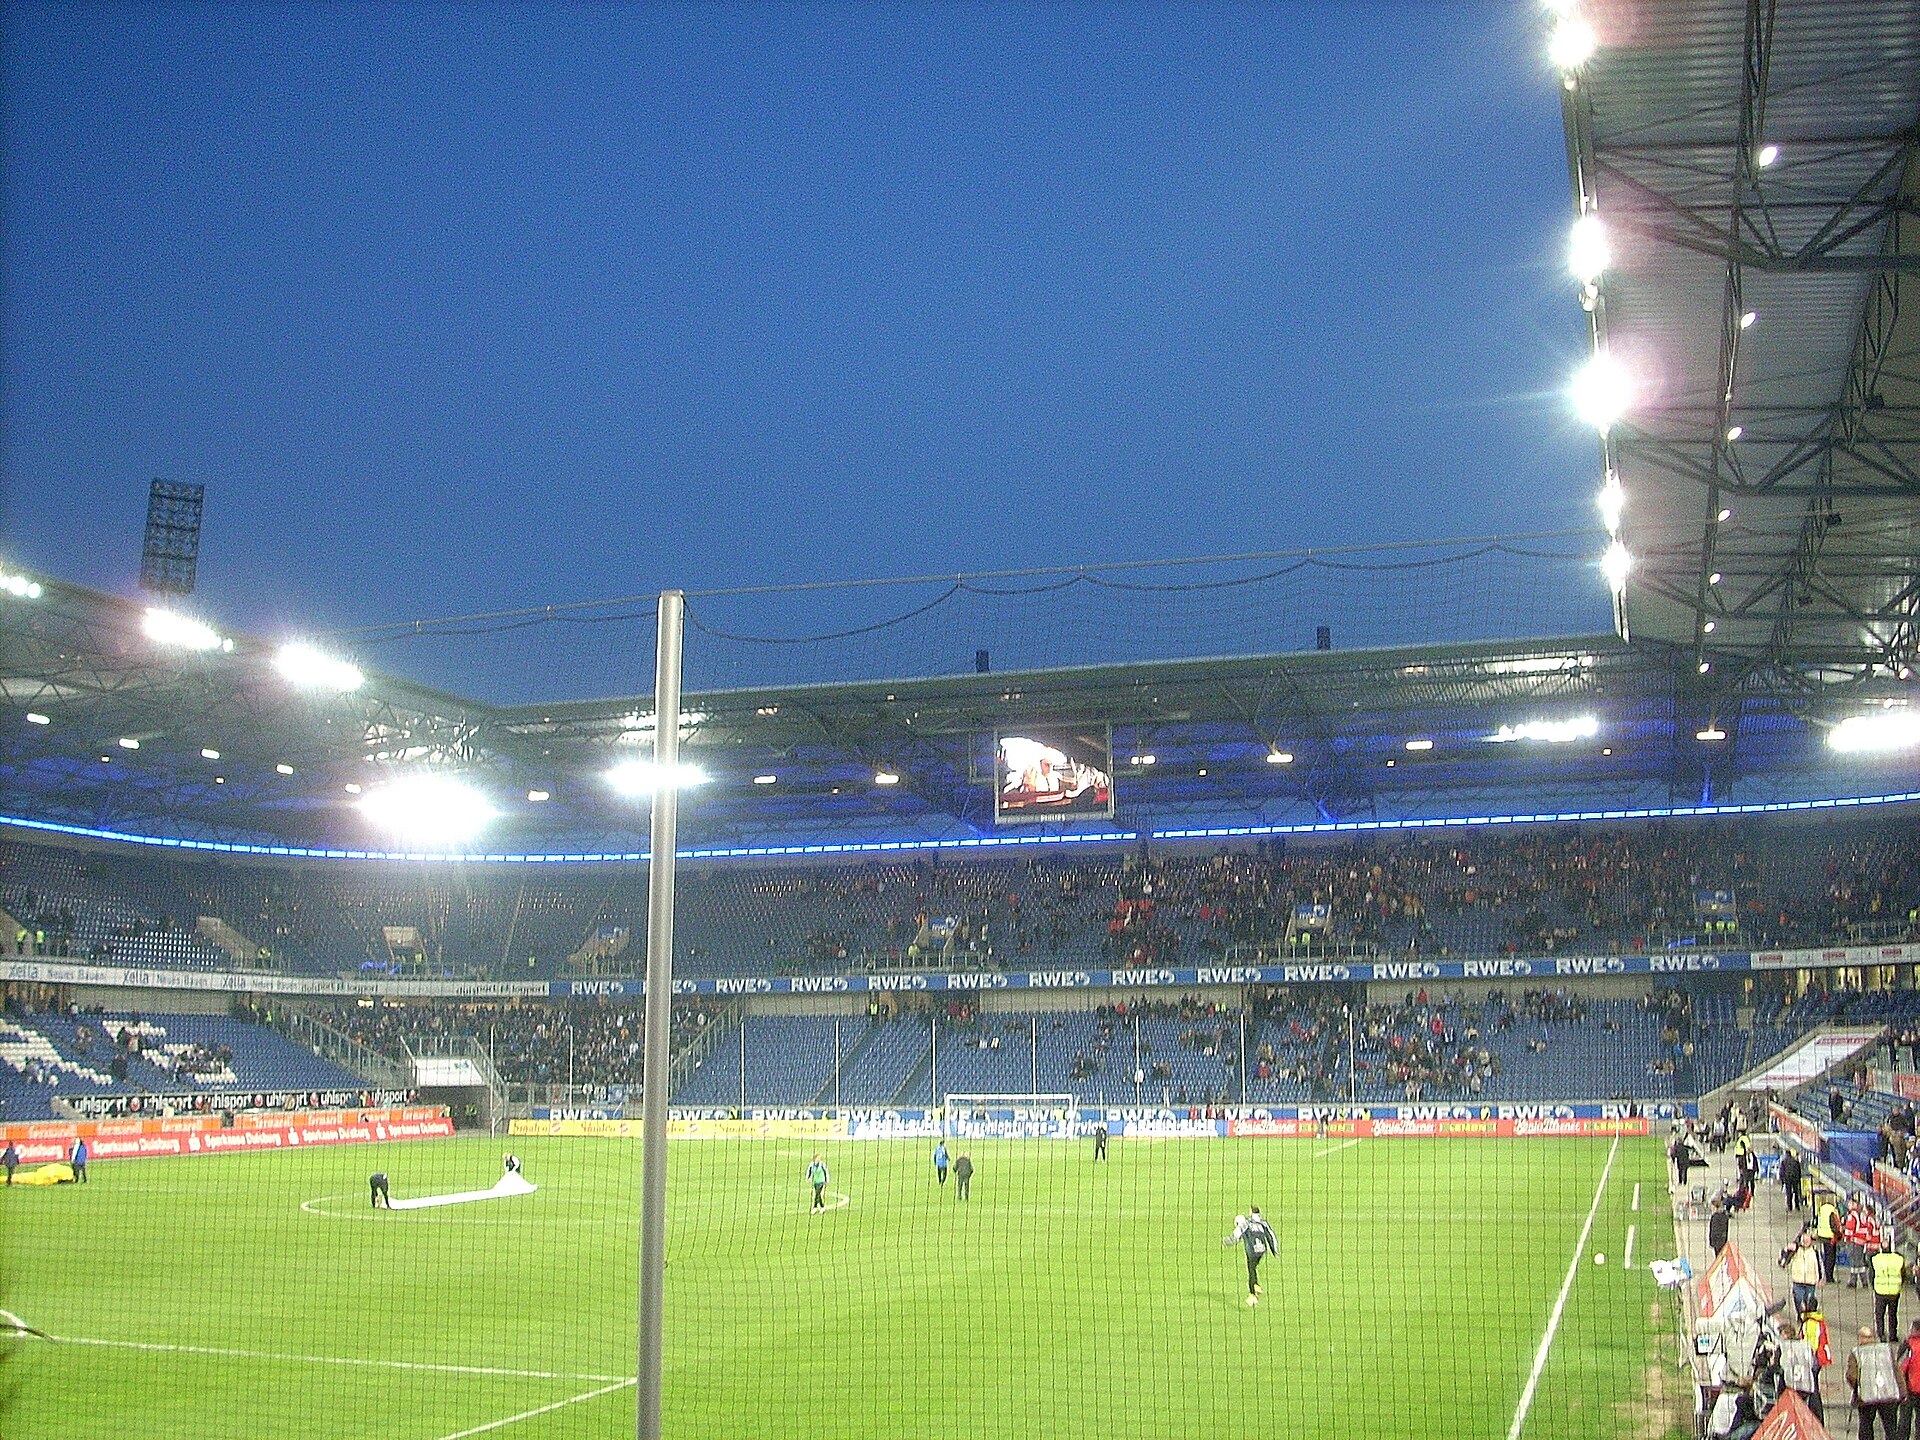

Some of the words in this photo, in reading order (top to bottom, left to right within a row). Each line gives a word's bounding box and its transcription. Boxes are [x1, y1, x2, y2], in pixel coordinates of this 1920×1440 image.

[1373, 963, 1422, 979] RWE
[1463, 960, 1513, 977] RWE
[1556, 958, 1606, 974] RWE
[1650, 955, 1700, 972] RWE
[123, 969, 149, 984] Xella
[947, 972, 992, 988] RWE
[1029, 972, 1075, 987] RWE
[1112, 970, 1158, 985] RWE
[1198, 967, 1245, 983] RWE
[1284, 966, 1332, 982] RWE
[222, 975, 247, 989] Xella
[571, 981, 610, 995] RWE
[716, 980, 757, 993] RWE
[791, 978, 833, 993] RWE
[868, 975, 911, 990] RWE
[550, 1108, 591, 1121] RWE
[1398, 1106, 1450, 1121] RWE
[1500, 1105, 1555, 1119] RWE
[302, 1129, 338, 1143] Sparkasse
[338, 1127, 371, 1141] Duisburg
[388, 1124, 420, 1138] Sparkasse
[420, 1122, 449, 1136] Duisburg
[92, 1139, 139, 1155] Sparkasse
[140, 1137, 180, 1152] Duisburg
[205, 1133, 246, 1150] Sparkasse
[246, 1132, 281, 1147] Duisburg
